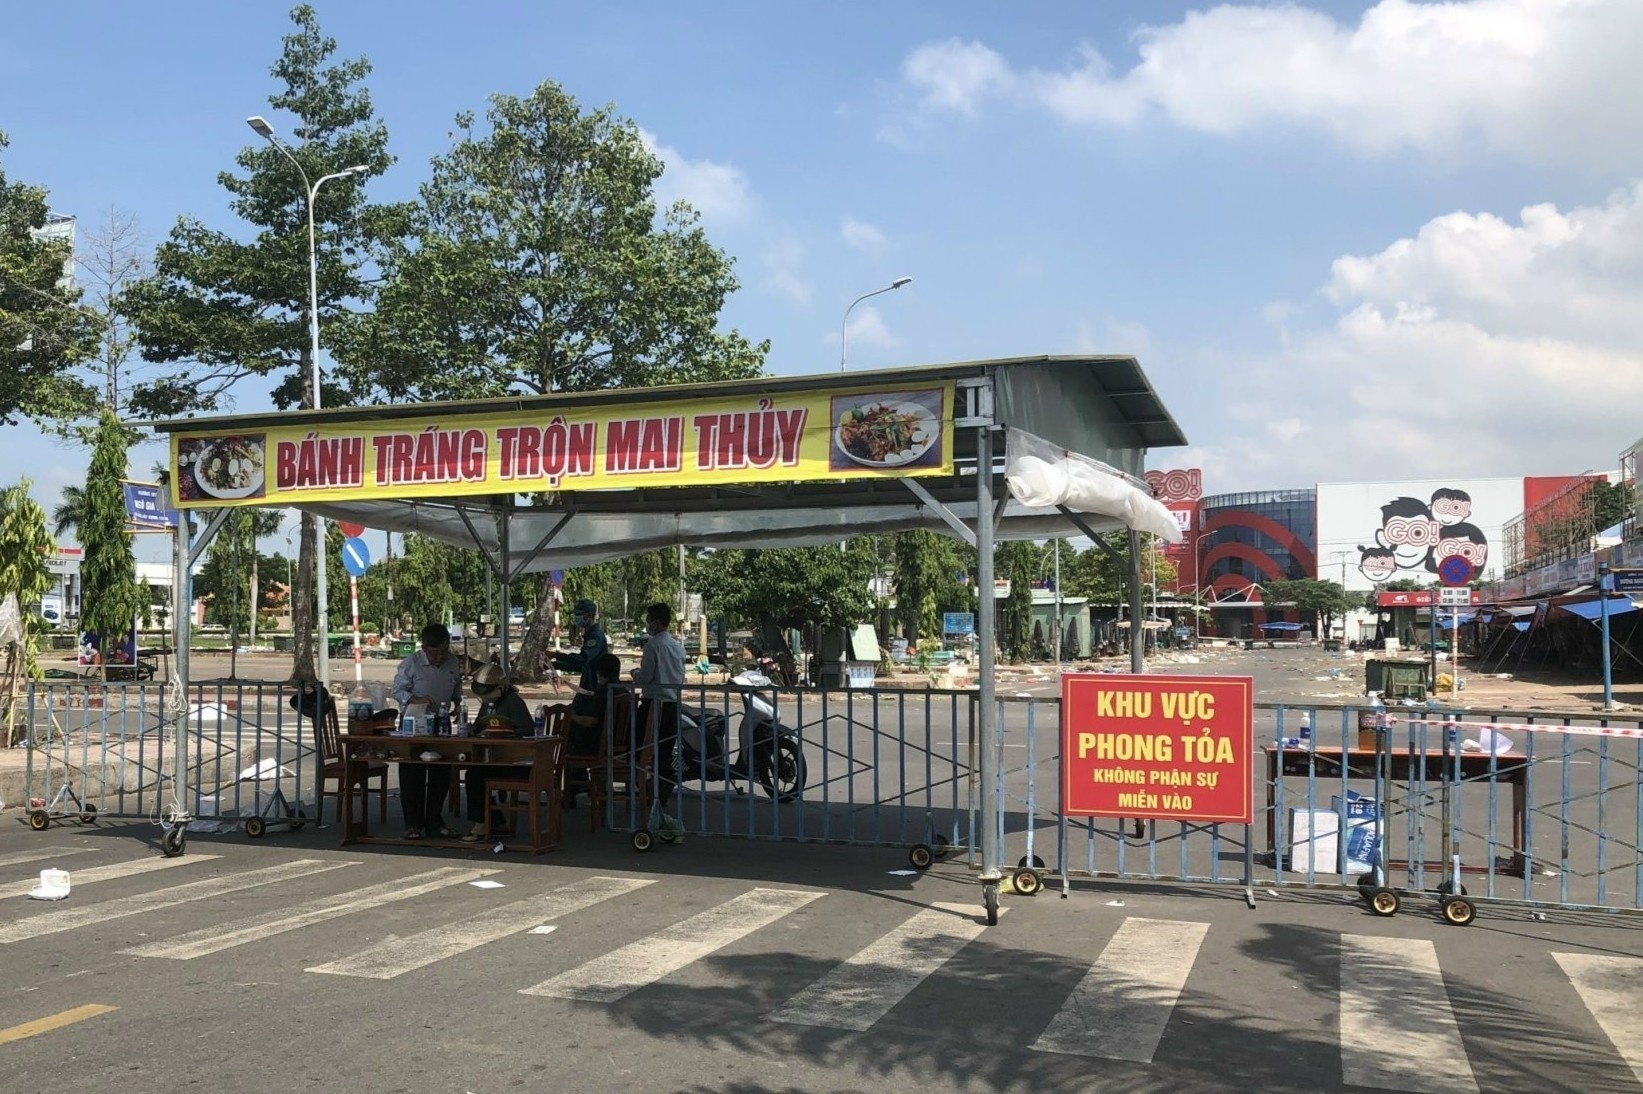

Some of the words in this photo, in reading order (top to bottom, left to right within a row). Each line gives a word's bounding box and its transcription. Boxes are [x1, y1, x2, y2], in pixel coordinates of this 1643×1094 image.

[276, 432, 364, 491] BÁNH
[372, 425, 488, 487] TRÁNG
[495, 415, 598, 488] TRỘN
[604, 415, 685, 474] MAI
[693, 397, 808, 471] THỦY
[1434, 498, 1472, 517] GO!
[1384, 519, 1440, 547] GO!
[1437, 537, 1487, 566] GO!
[1097, 690, 1152, 718] KHU
[1160, 690, 1215, 725] VỰC
[1078, 732, 1172, 762] PHONG
[1181, 727, 1235, 764] TỎA
[1093, 766, 1145, 785] KHÔNG
[1150, 768, 1192, 788] PHẬN
[1196, 771, 1219, 790] SỰ
[1118, 789, 1157, 809] MIỄN
[1162, 792, 1192, 810] VÀO
